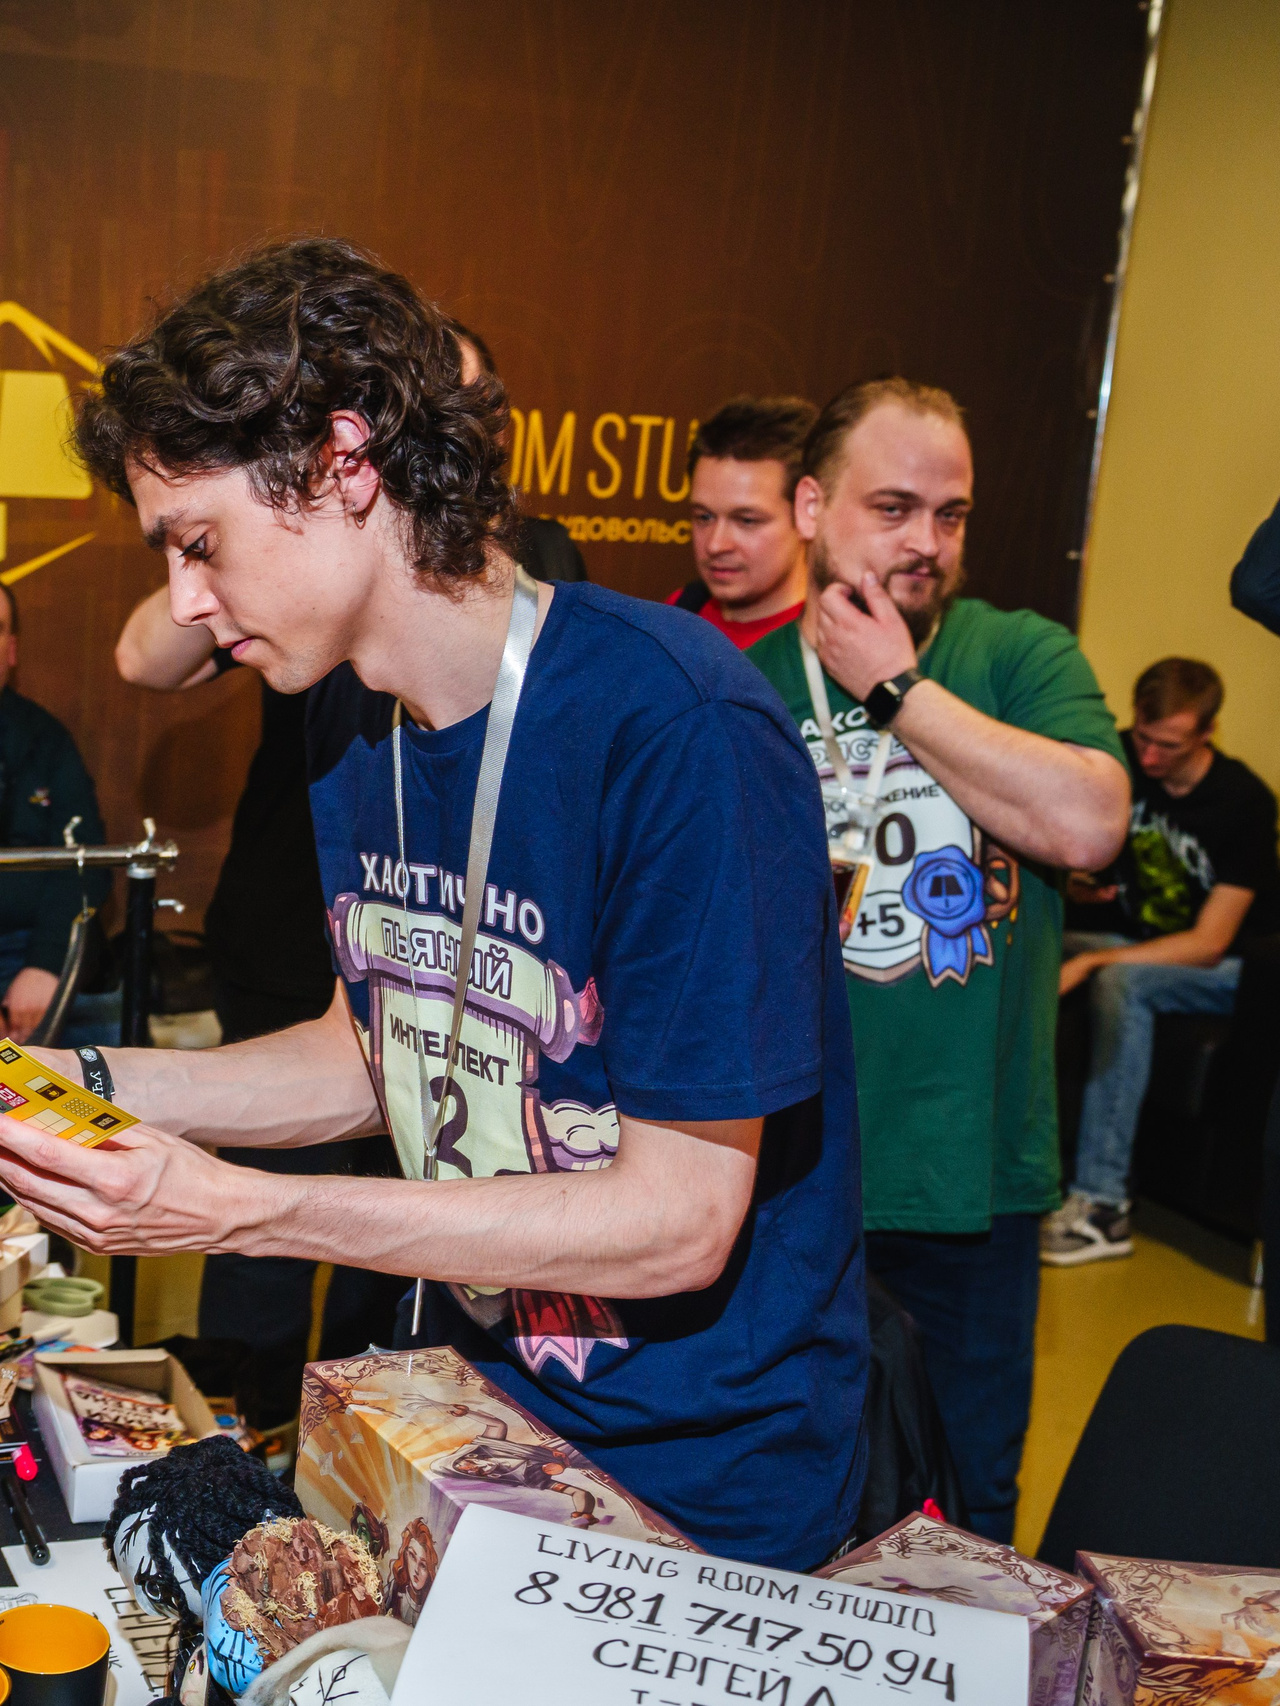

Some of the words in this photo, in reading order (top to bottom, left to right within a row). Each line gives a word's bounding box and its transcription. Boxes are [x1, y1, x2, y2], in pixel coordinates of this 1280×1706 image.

[856, 902, 906, 938] +5
[536, 1533, 679, 1579] LIVING
[696, 1566, 799, 1605] ROOM
[808, 1589, 937, 1637] STUDIO
[592, 1638, 792, 1705] СЕРГЕЙ
[685, 1601, 804, 1652] 747
[881, 1648, 957, 1702] 94
